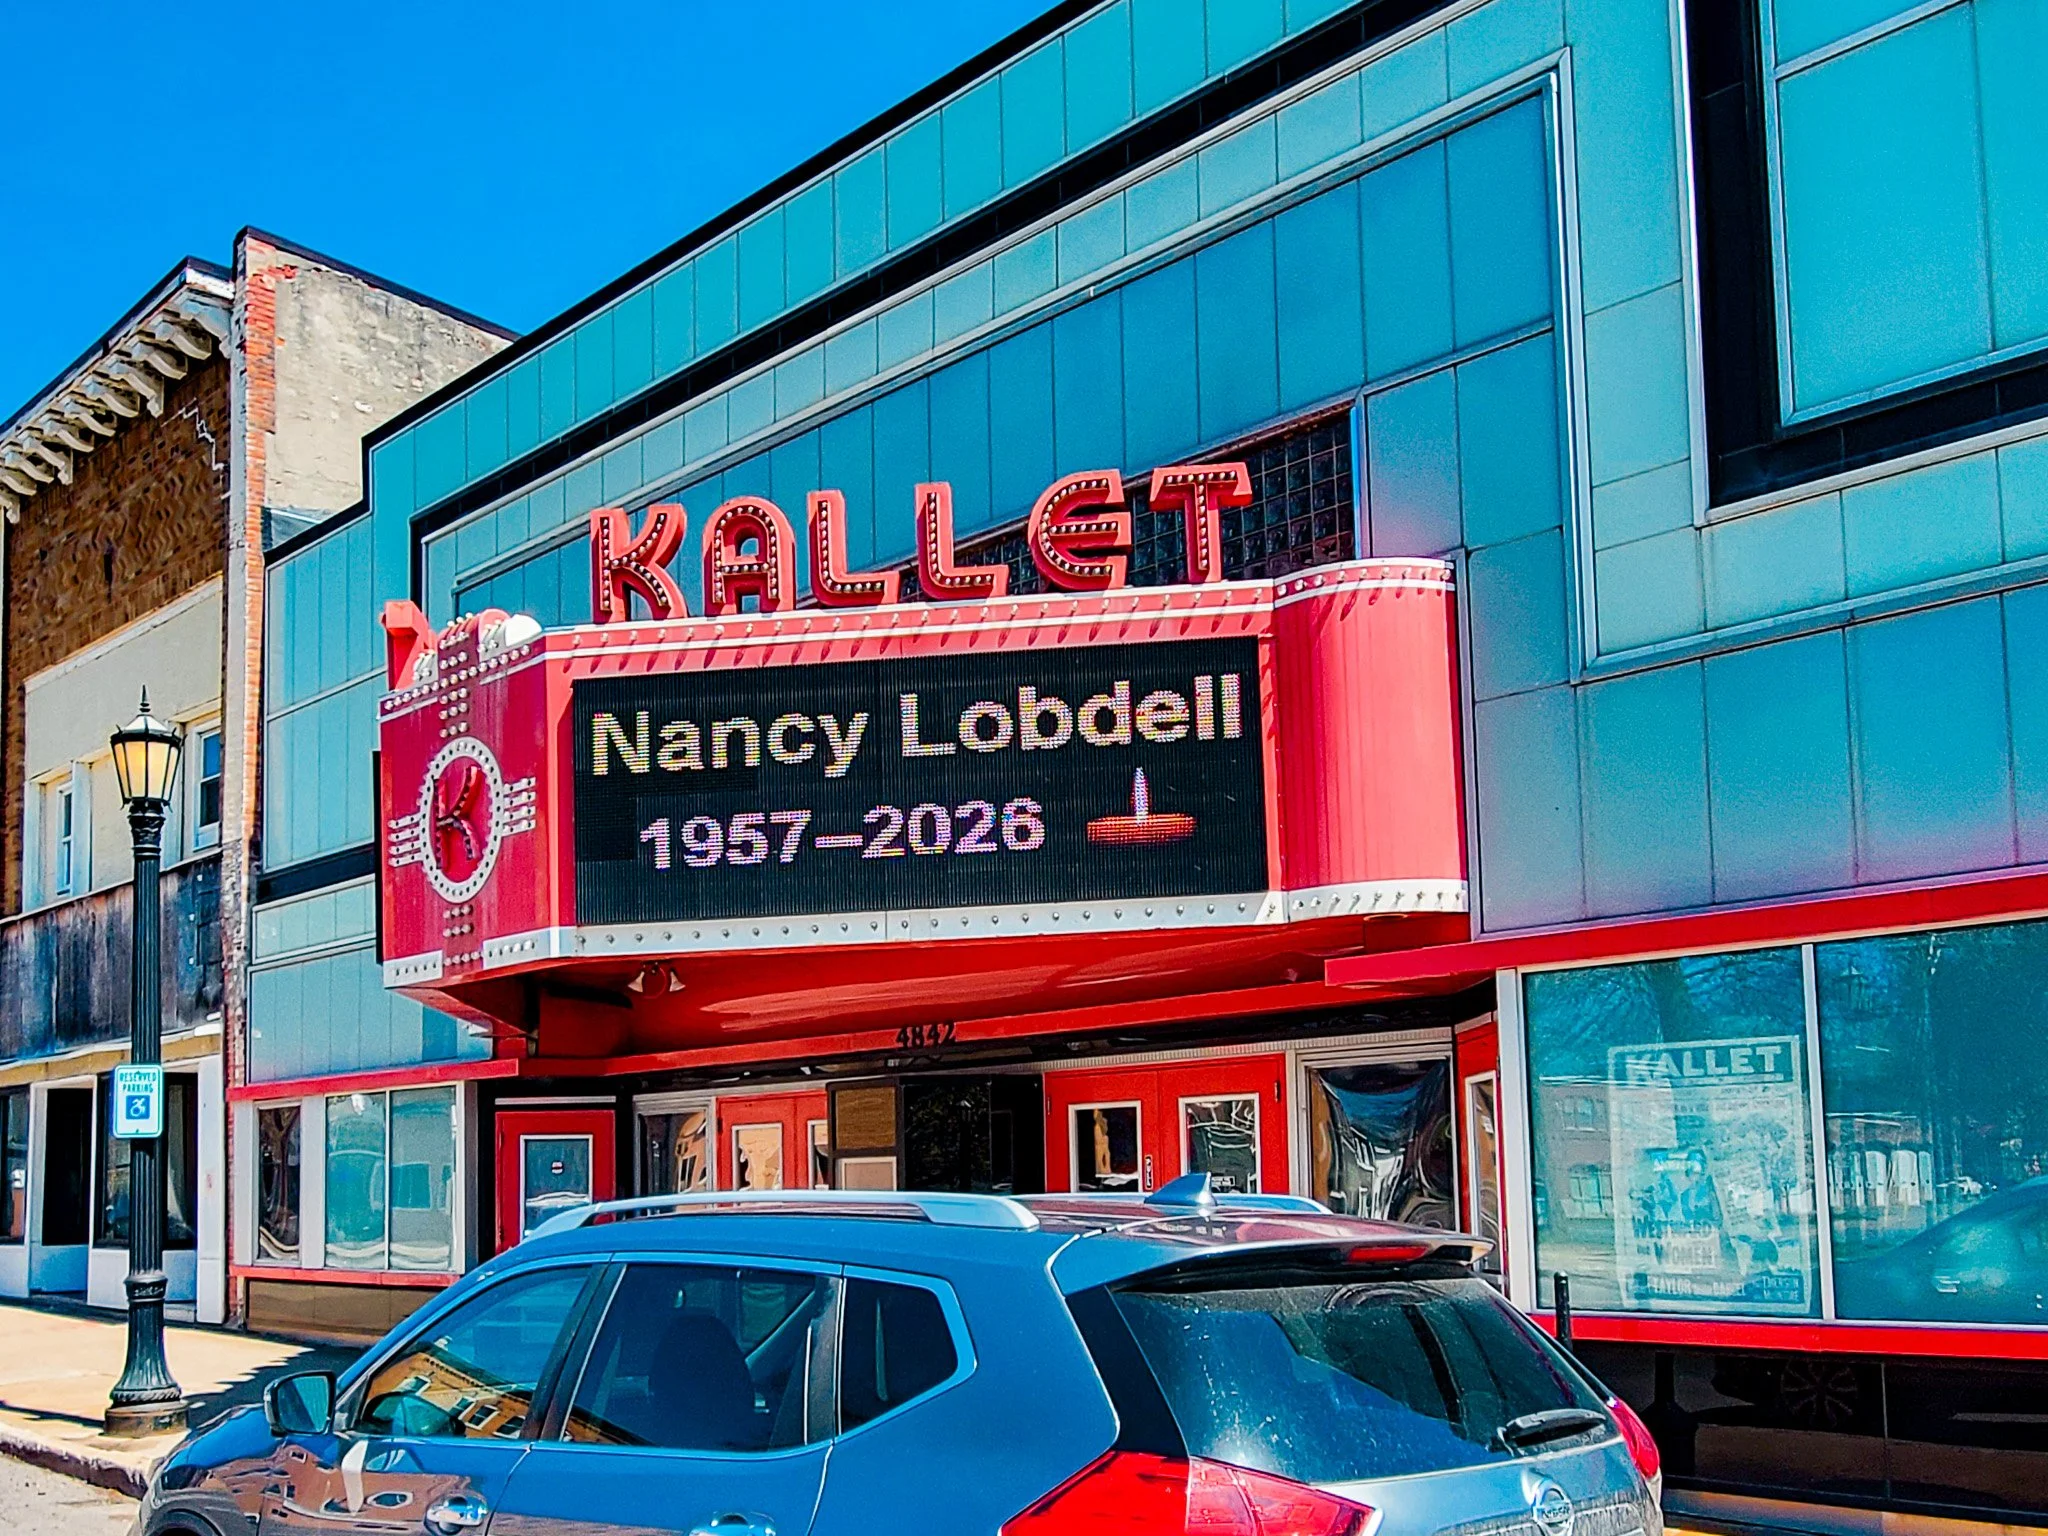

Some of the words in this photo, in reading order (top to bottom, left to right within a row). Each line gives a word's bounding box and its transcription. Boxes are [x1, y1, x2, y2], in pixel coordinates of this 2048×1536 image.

[590, 462, 1253, 623] KALLET
[591, 708, 870, 778] Nancy
[900, 672, 1243, 758] Lobdell
[895, 1021, 955, 1048] 4842
[119, 1072, 157, 1082] RESERVED
[1624, 1046, 1782, 1082] KALLET
[122, 1083, 154, 1093] PARKING
